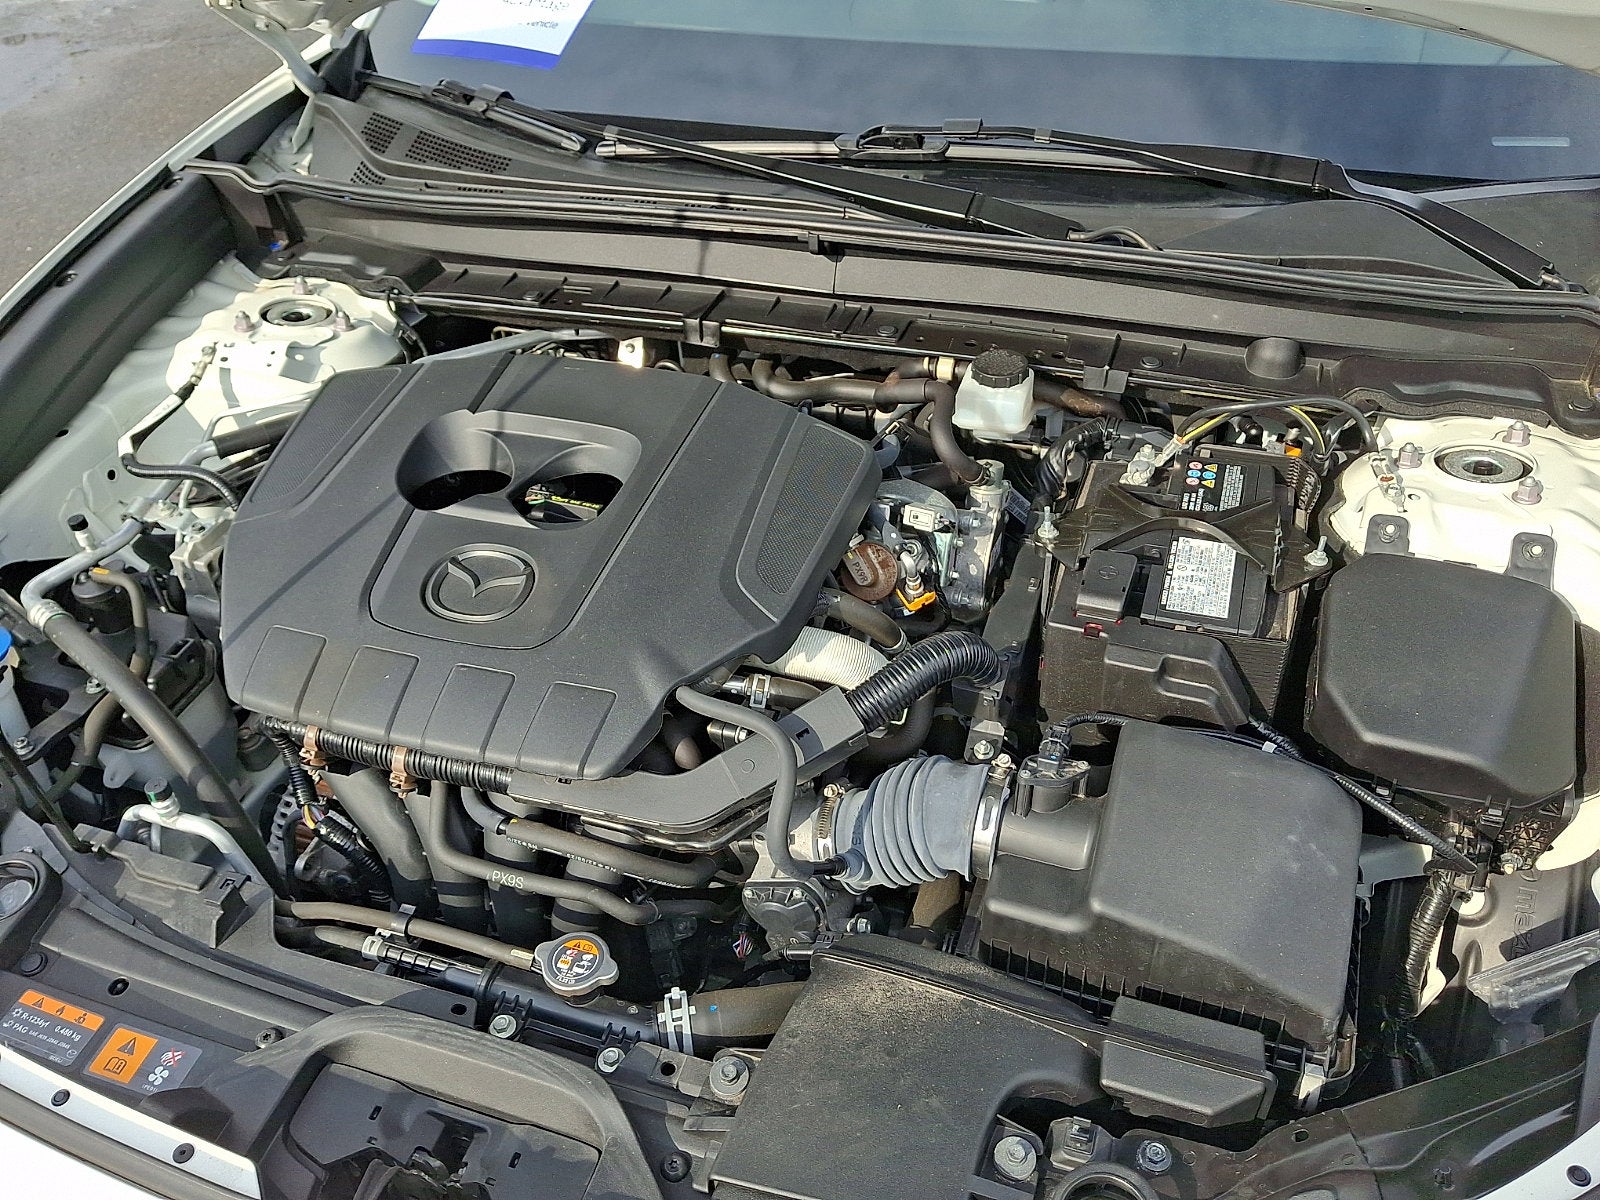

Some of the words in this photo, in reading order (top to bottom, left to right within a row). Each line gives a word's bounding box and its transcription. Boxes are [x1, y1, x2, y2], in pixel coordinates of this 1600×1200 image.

[852, 561, 869, 584] PX9R
[492, 870, 524, 889] PX9S
[12, 1022, 29, 1034] PAG
[71, 1031, 82, 1042] kg
